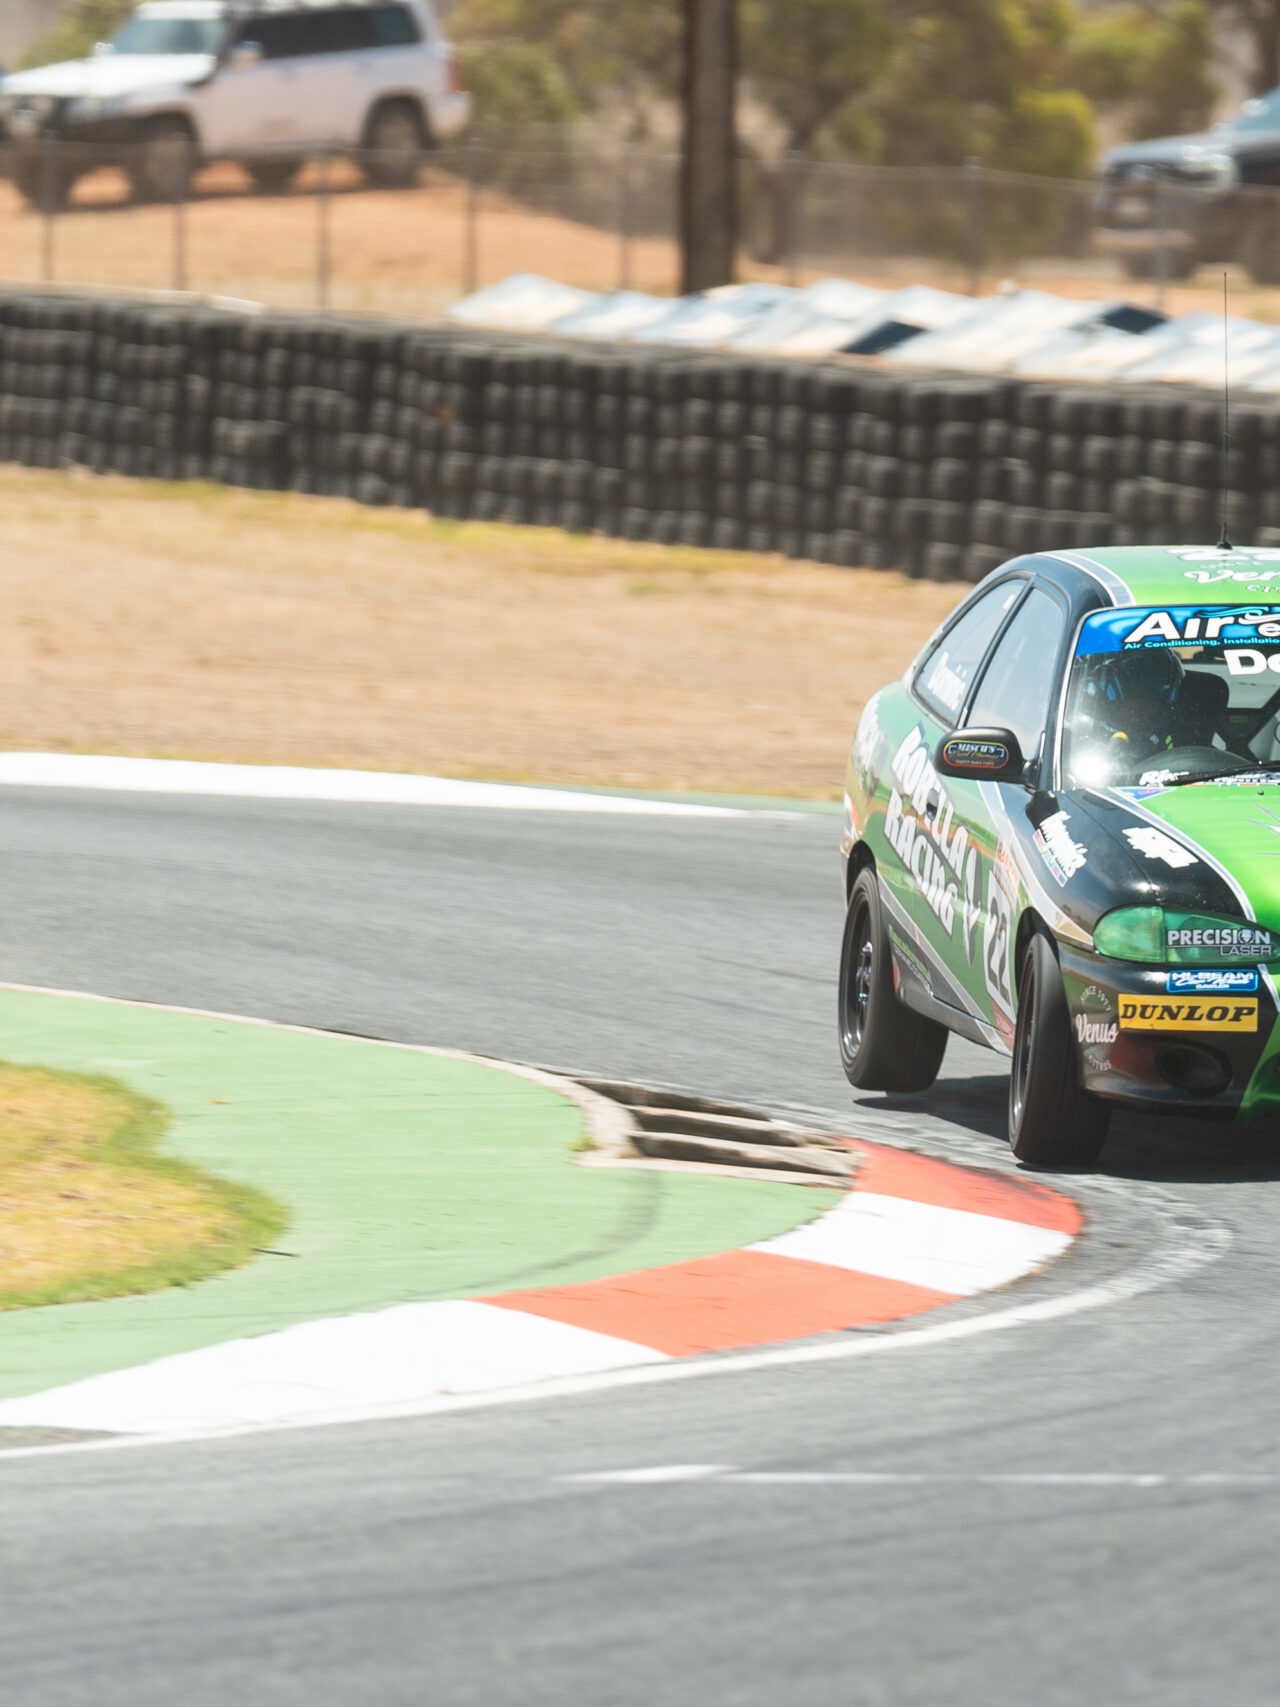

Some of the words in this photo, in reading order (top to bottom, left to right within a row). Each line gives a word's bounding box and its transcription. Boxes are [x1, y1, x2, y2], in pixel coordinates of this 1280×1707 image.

[1123, 611, 1235, 642] Air
[1144, 638, 1221, 648] Conditioning,
[1167, 928, 1271, 946] PRECISION
[1219, 945, 1272, 956] LASER
[1120, 1003, 1256, 1022] DUNLOP
[1075, 1013, 1119, 1043] Venus
